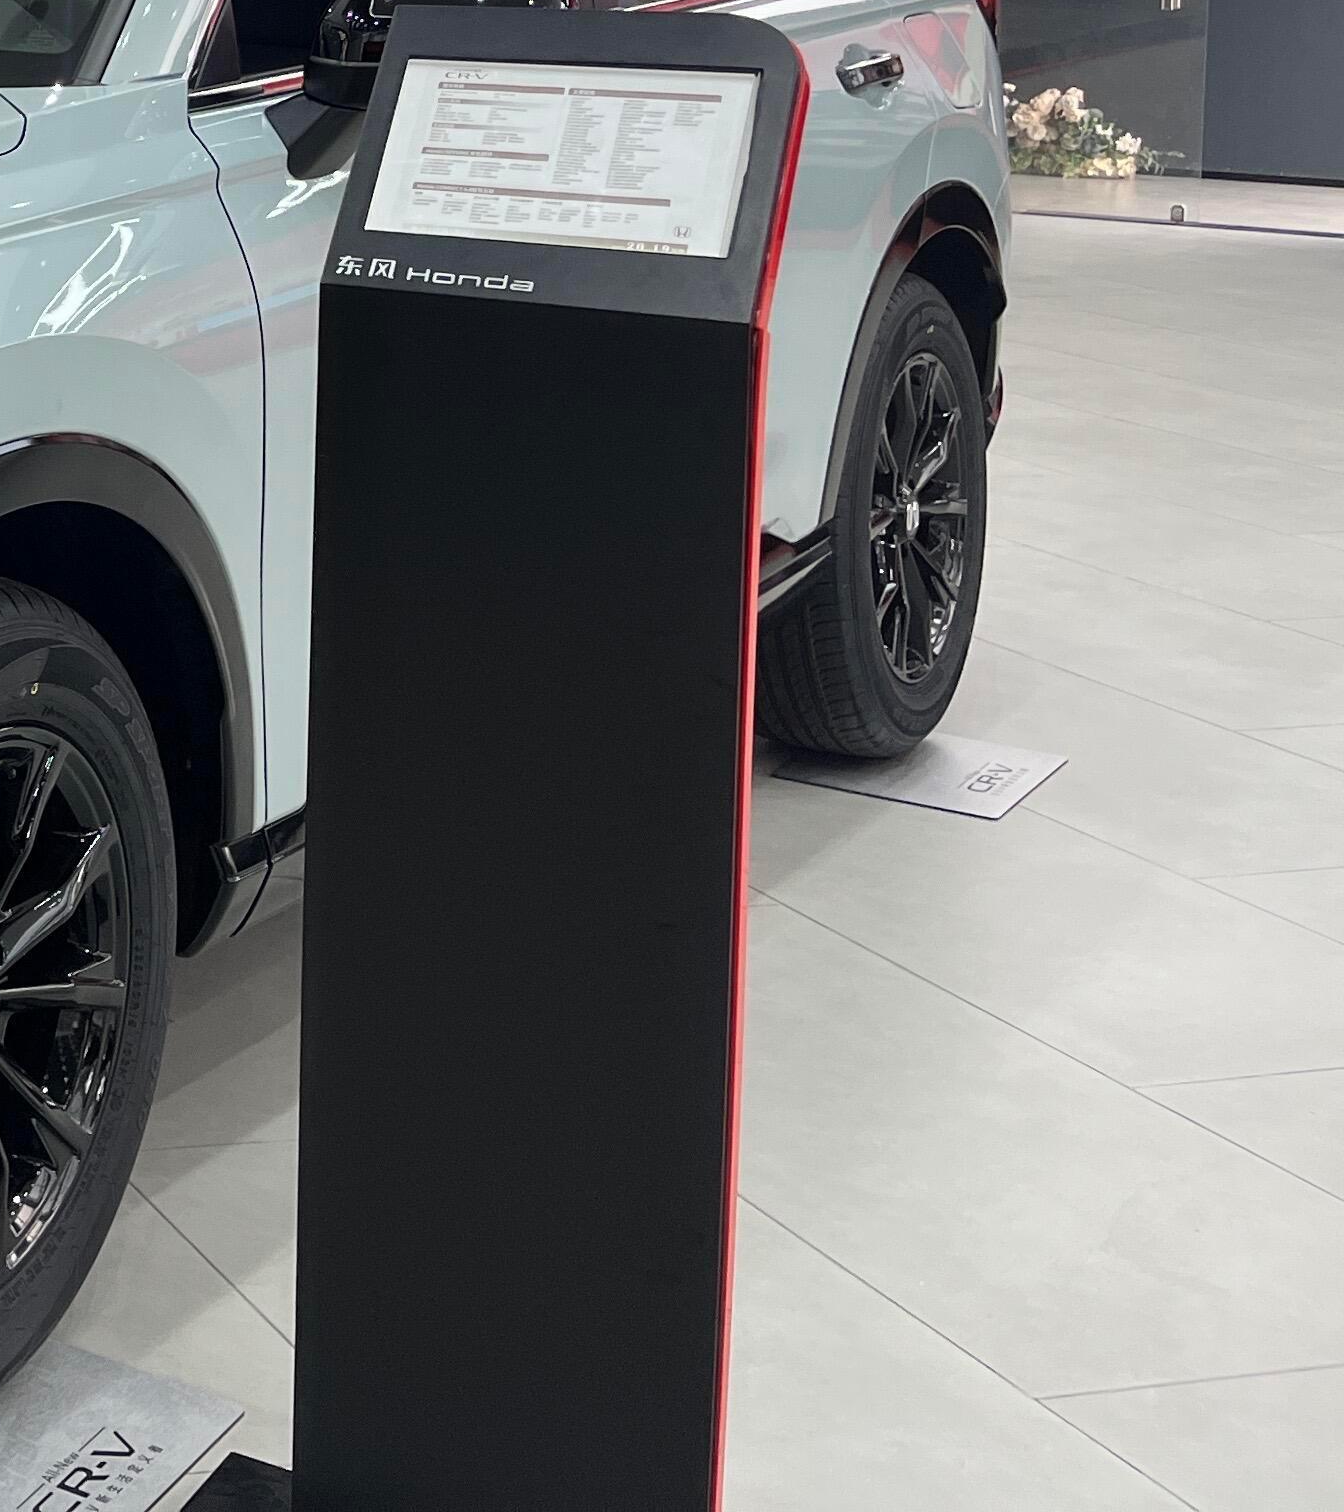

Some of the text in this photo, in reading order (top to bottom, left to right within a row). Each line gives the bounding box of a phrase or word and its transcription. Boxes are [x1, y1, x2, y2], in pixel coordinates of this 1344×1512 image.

[445, 71, 489, 80] CR-V
[336, 255, 535, 292] 东风 Honda
[967, 763, 1013, 792] CR-V
[41, 1450, 81, 1484] All-New
